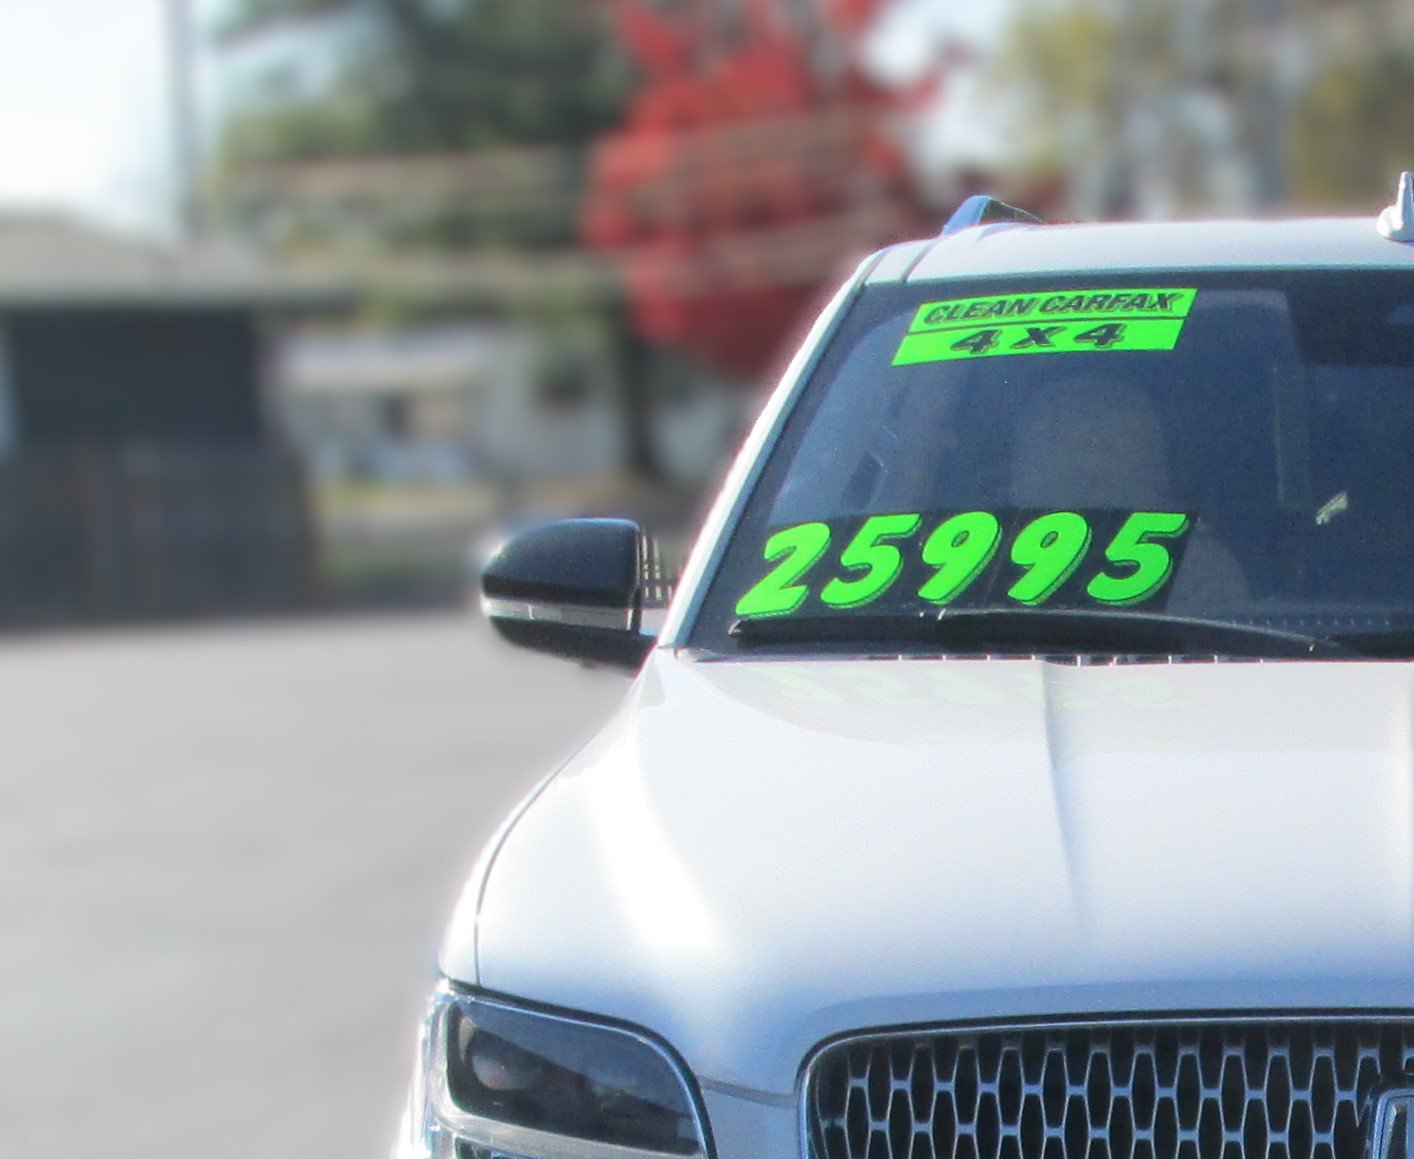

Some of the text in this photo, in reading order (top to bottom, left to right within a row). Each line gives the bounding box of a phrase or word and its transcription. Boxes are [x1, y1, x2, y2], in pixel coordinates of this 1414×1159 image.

[923, 292, 1184, 324] CLEAN CARFAX
[734, 510, 1190, 618] 25995
